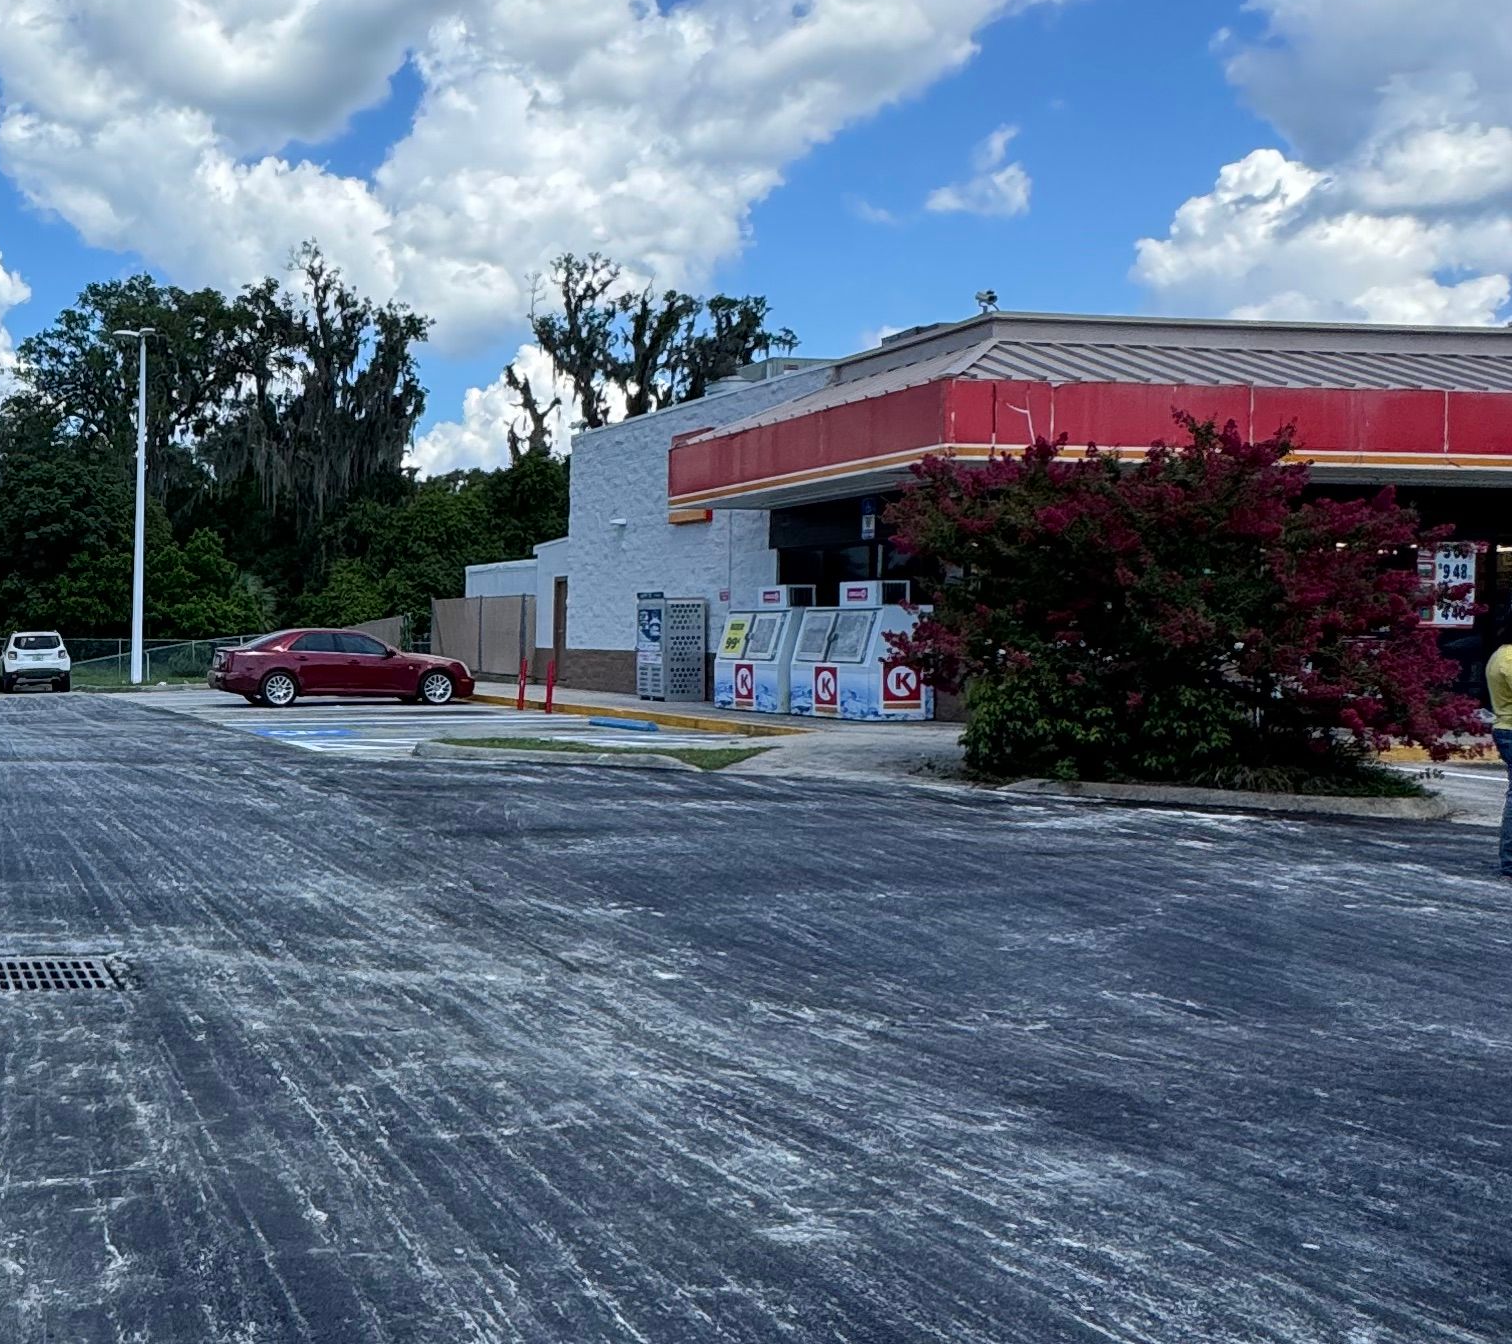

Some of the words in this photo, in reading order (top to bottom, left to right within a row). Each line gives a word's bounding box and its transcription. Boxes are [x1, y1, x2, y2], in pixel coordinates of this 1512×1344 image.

[741, 674, 752, 691] K
[822, 677, 834, 695] K
[895, 672, 913, 692] K
